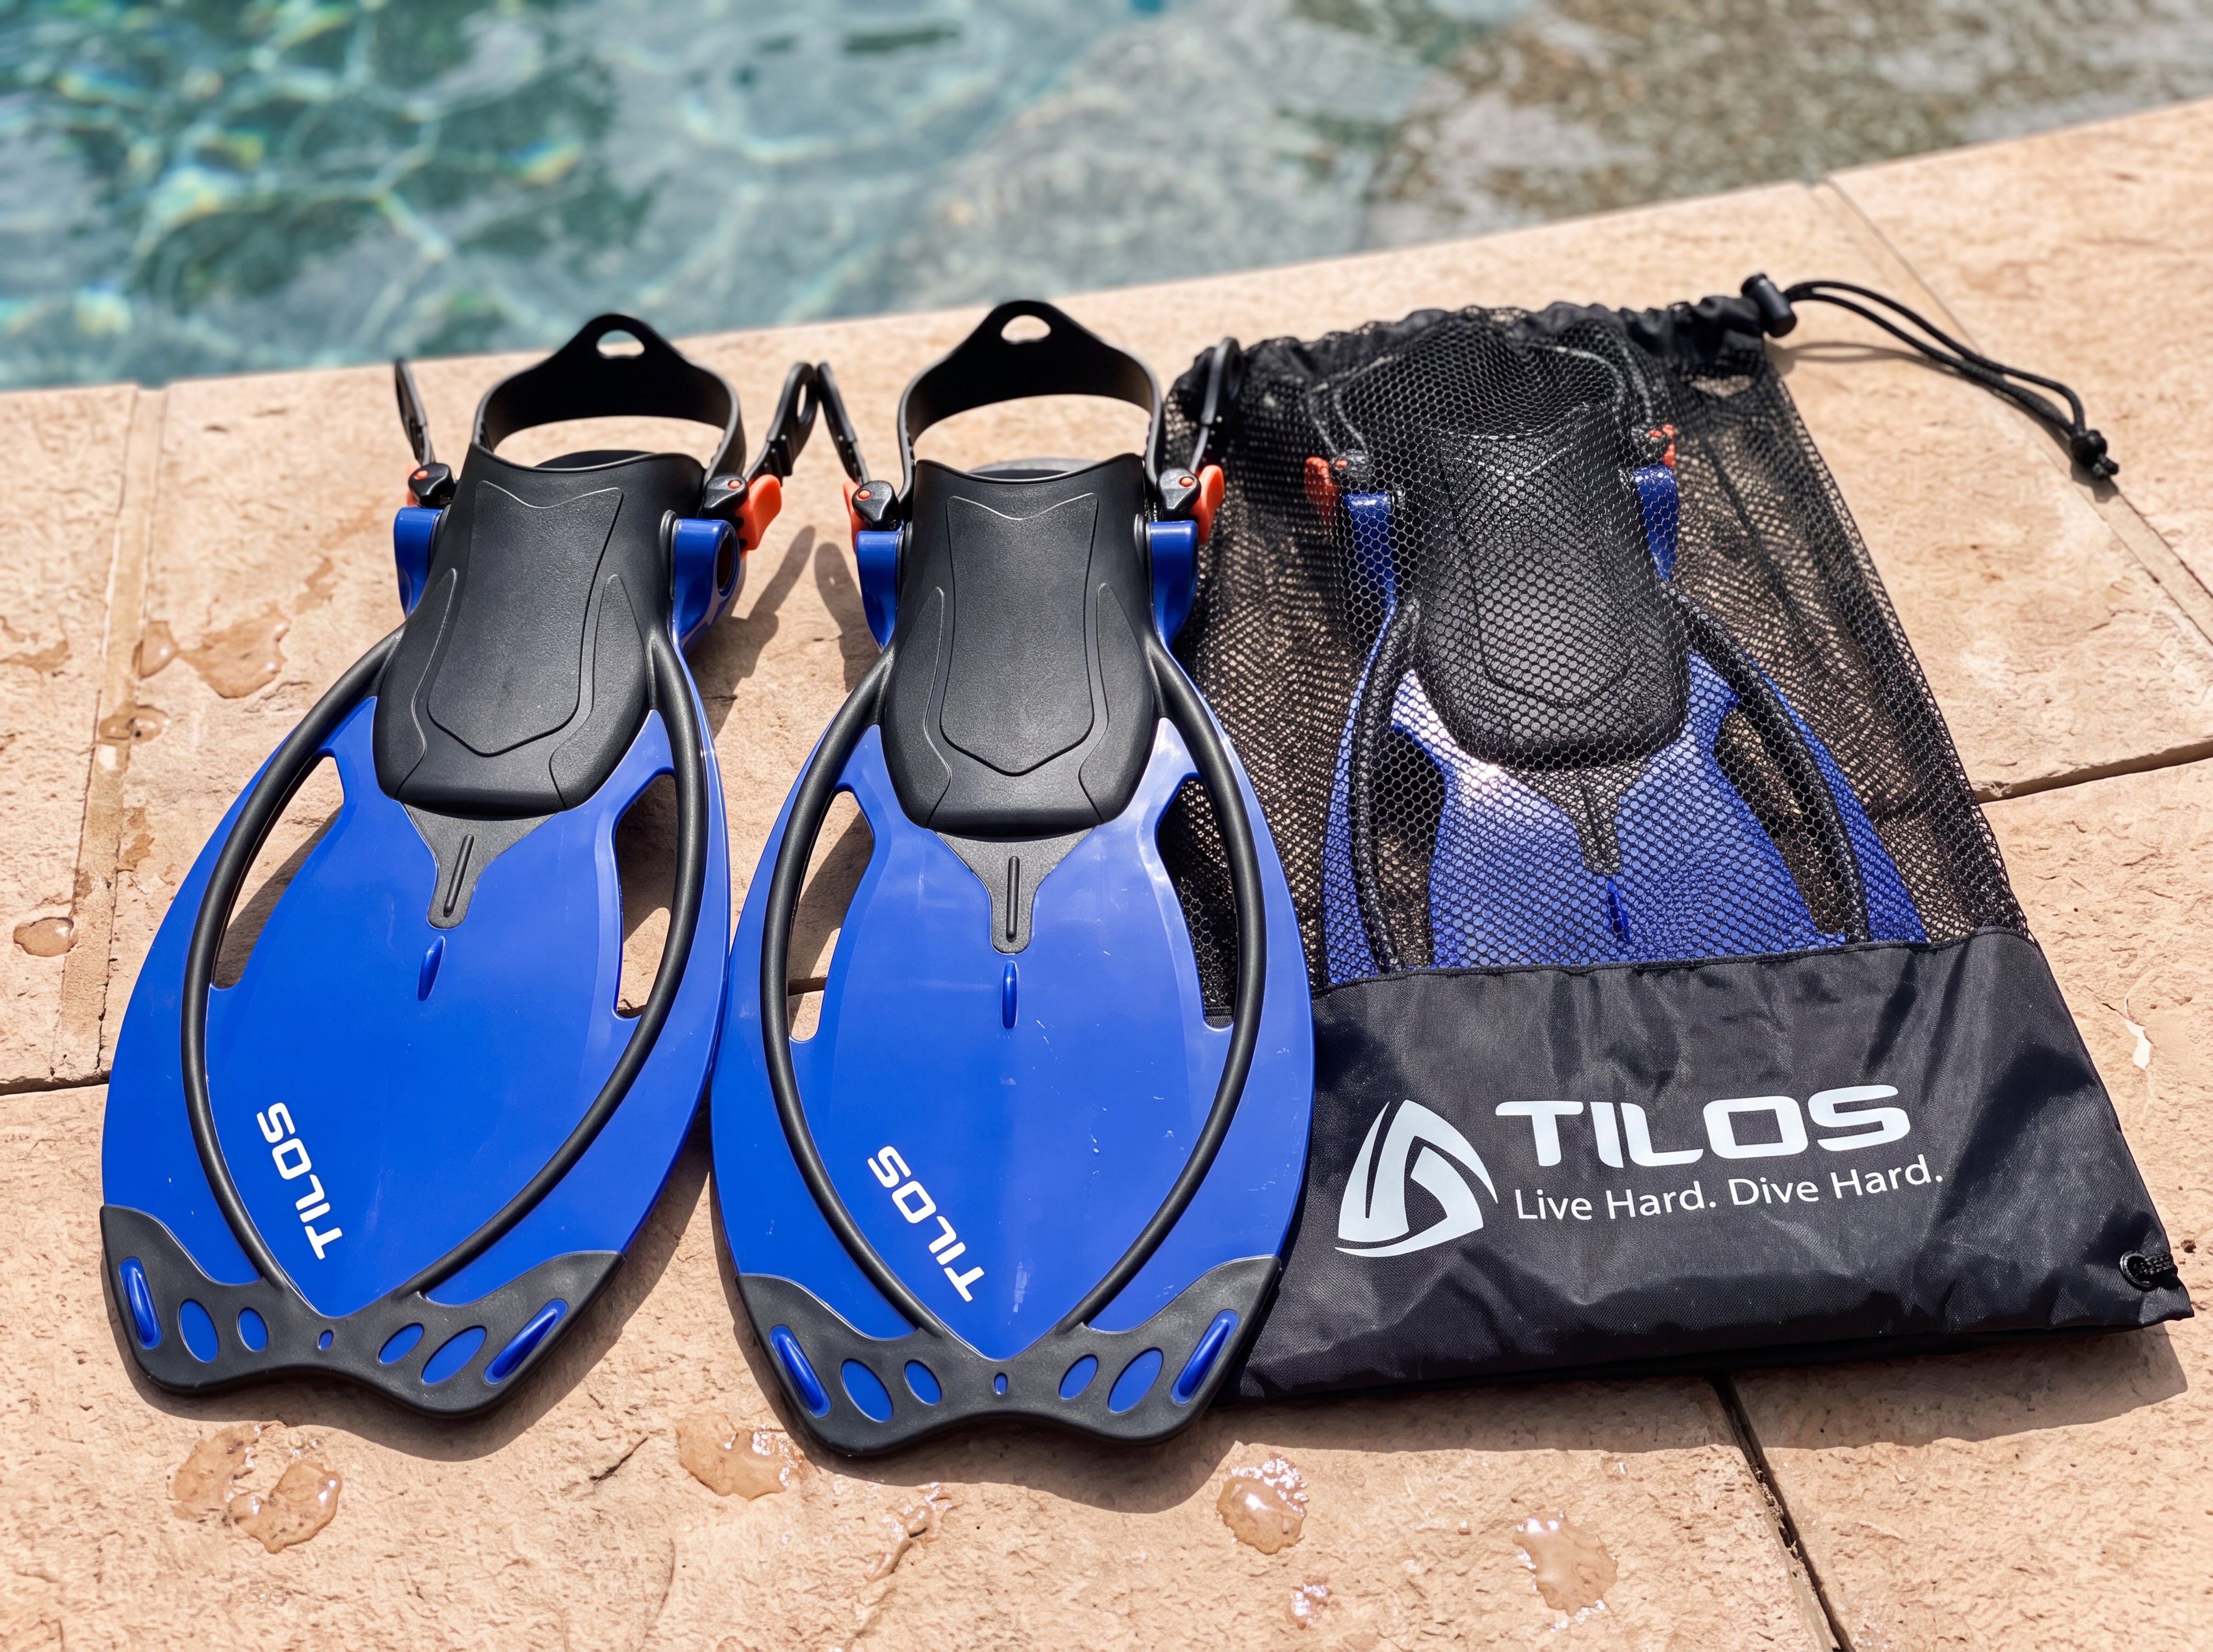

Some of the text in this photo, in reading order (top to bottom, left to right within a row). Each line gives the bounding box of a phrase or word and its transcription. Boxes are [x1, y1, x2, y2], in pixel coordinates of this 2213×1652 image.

[256, 1102, 343, 1260] TILOS
[1495, 1084, 1911, 1168] TILOS
[867, 1146, 985, 1302] TILOS
[1515, 1153, 1943, 1221] Live Hard. Dive Hard.
